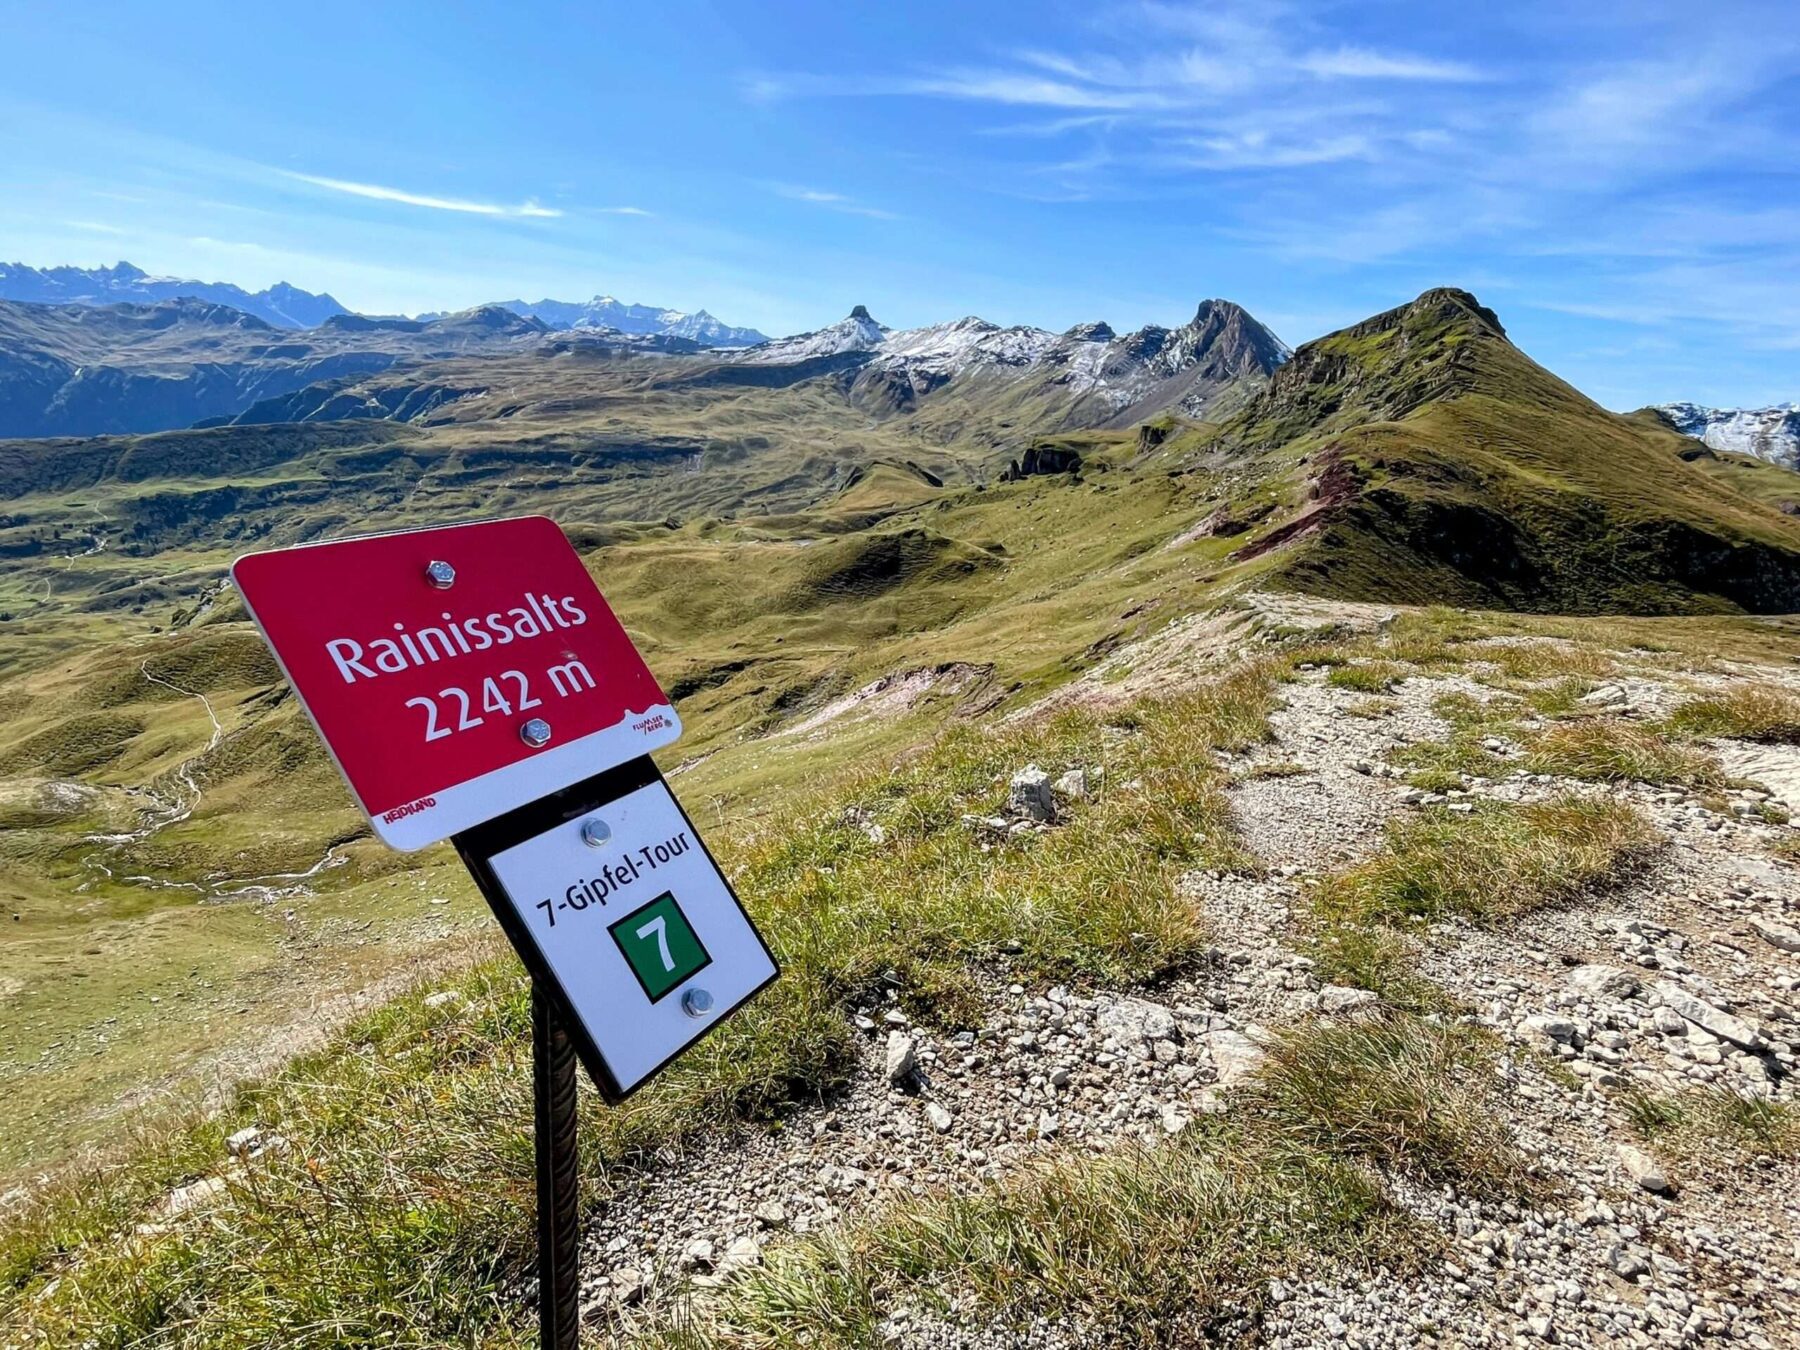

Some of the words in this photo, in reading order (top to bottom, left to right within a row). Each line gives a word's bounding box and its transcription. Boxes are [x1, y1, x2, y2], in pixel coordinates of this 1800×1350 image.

[325, 592, 588, 684] Rainissalts
[405, 670, 543, 743] 2242
[546, 660, 597, 698] m
[382, 797, 437, 825] HEIDILAND
[536, 832, 690, 928] 7-Gipfel-Tour
[635, 915, 676, 973] 7
